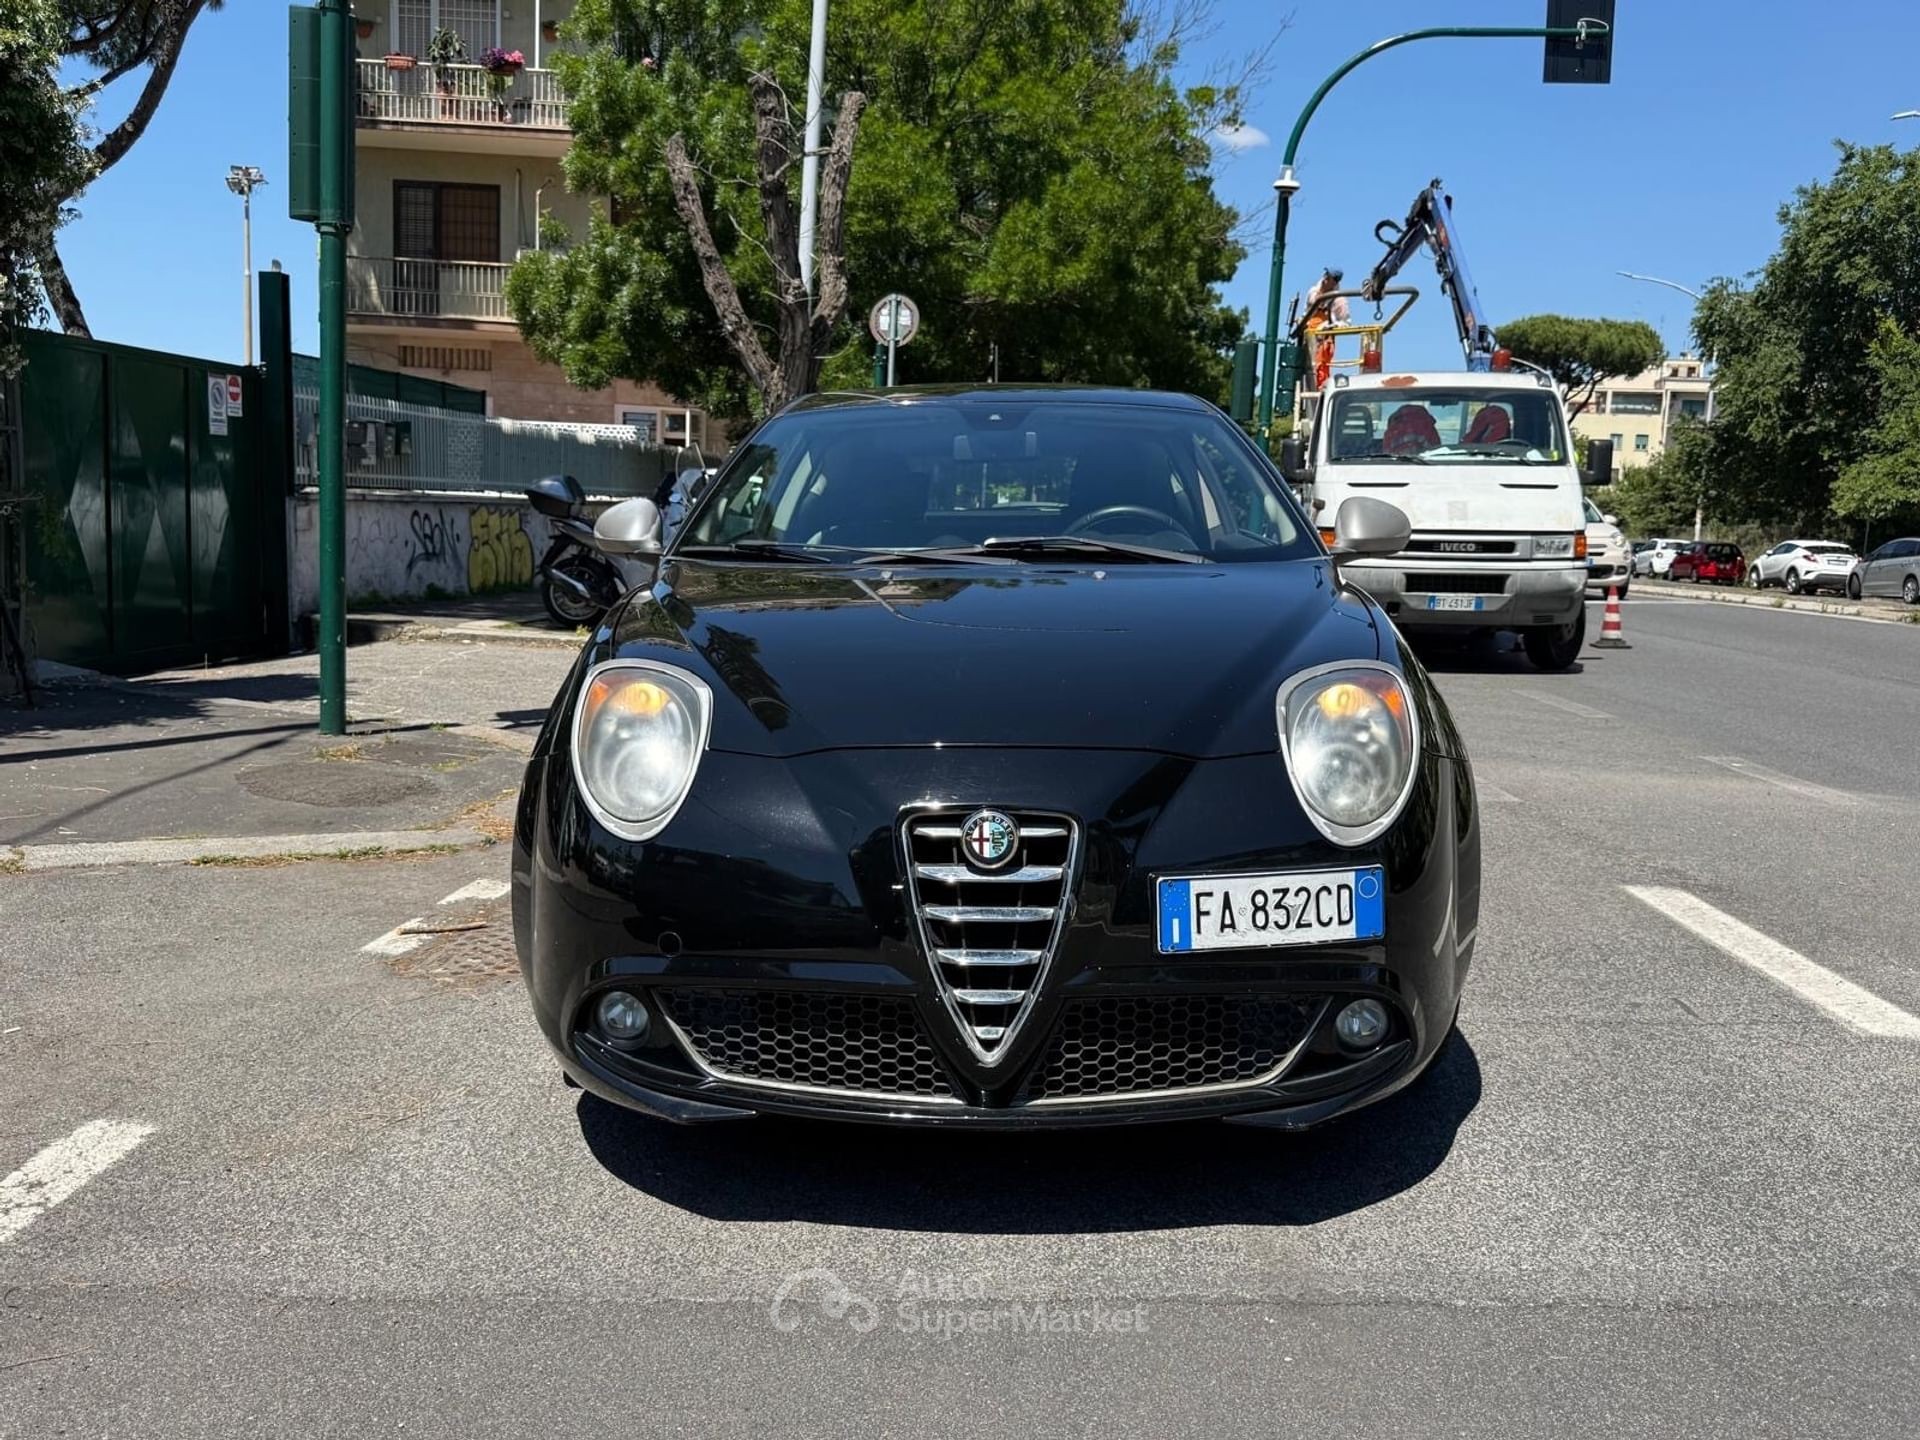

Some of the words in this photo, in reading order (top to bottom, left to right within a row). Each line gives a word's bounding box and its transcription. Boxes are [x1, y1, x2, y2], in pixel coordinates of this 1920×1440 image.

[1440, 542, 1476, 551] IVECO
[1194, 891, 1237, 935] FA
[1251, 883, 1354, 931] 832CD
